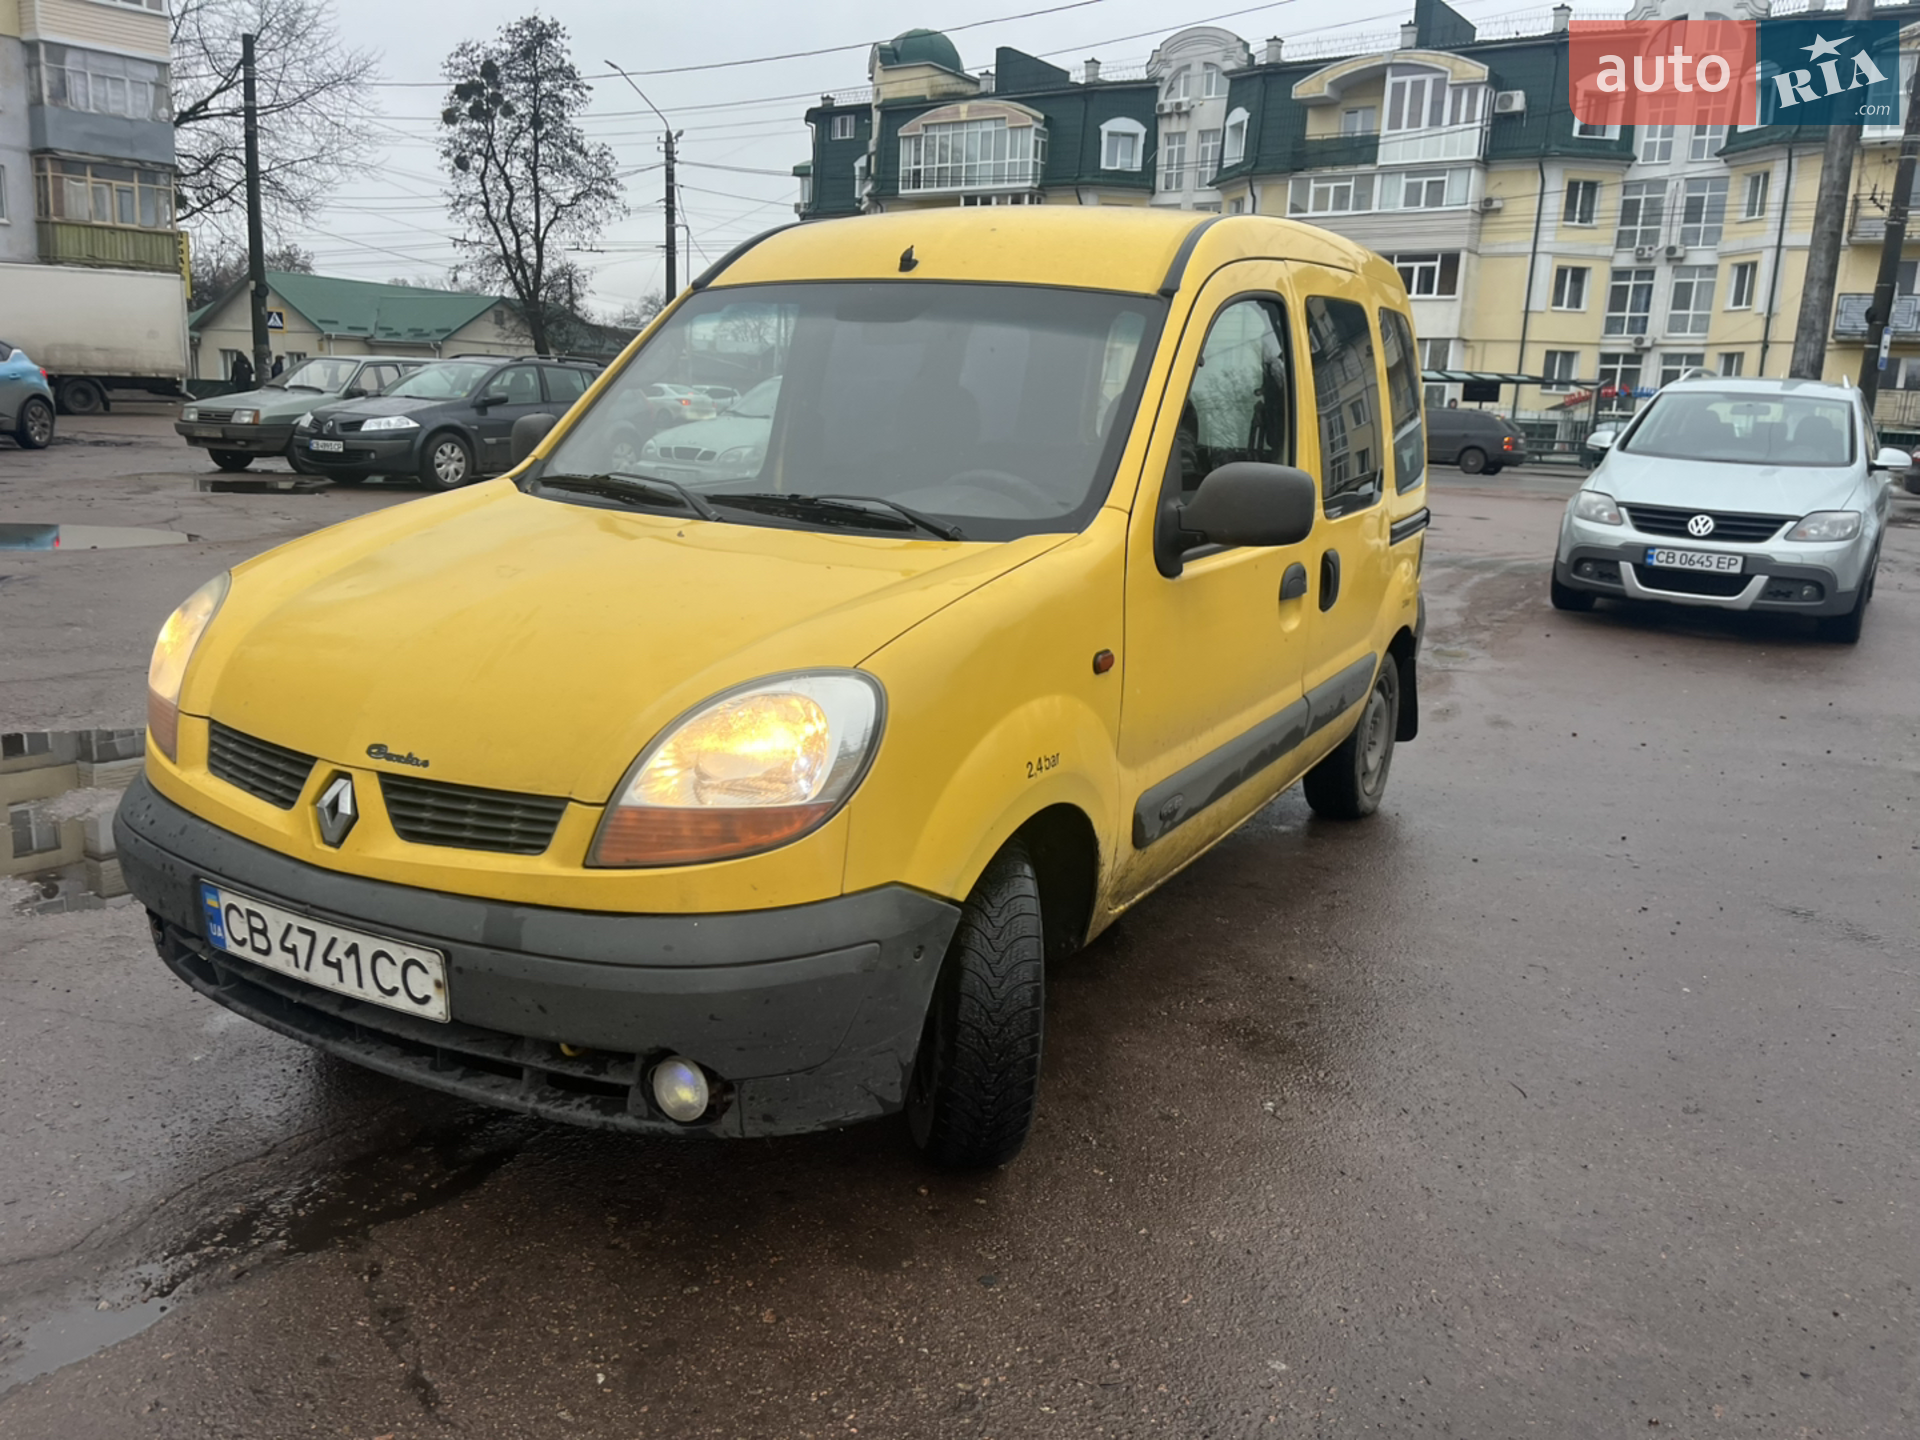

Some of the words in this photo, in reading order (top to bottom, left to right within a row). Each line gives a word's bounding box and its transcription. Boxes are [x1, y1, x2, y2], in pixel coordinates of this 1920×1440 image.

[1655, 550, 1677, 565] CB
[1679, 552, 1714, 569] 0645
[1715, 555, 1739, 570] EP
[209, 921, 225, 939] UA
